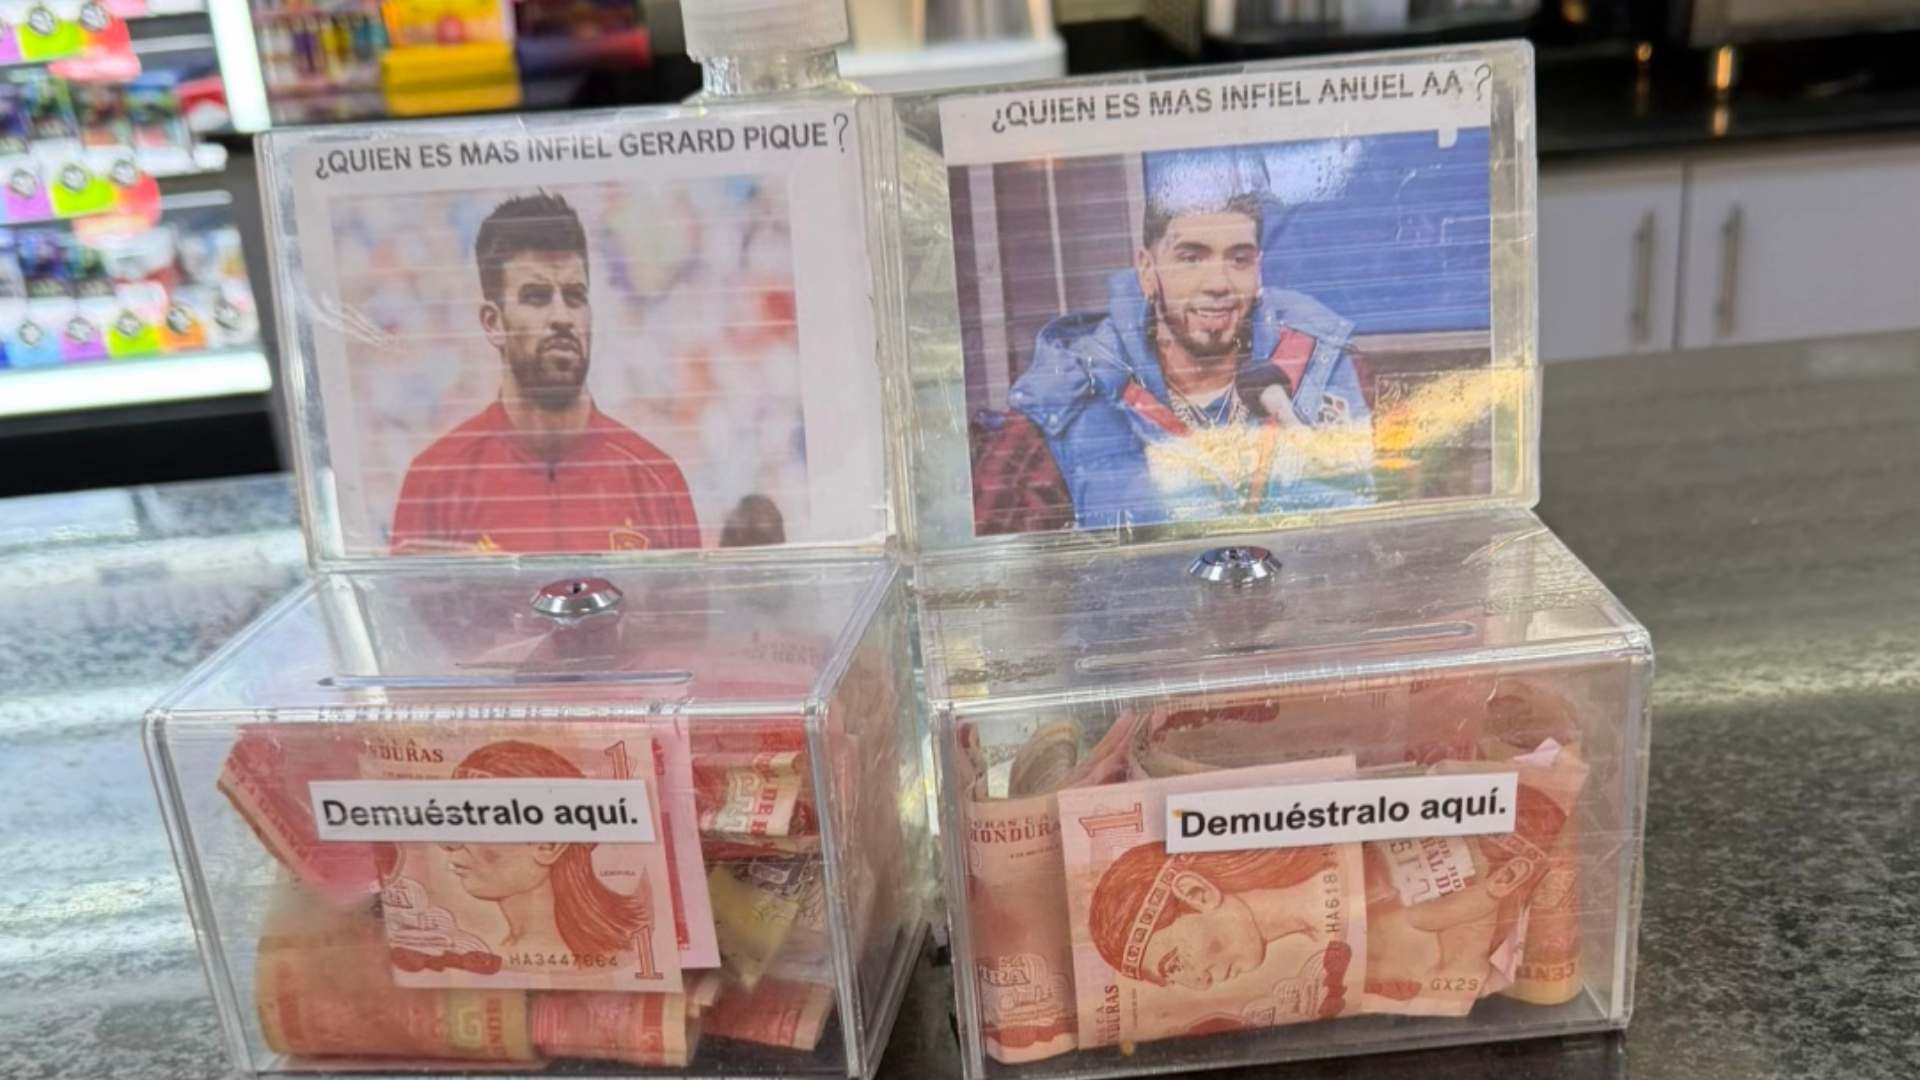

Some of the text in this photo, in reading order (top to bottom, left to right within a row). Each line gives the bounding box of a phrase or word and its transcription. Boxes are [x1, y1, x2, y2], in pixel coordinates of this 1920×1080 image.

[990, 95, 1096, 133] ¿QUIEN
[1105, 94, 1141, 120] ES
[1149, 87, 1214, 117] MAS
[1221, 79, 1312, 110] INFIEL
[1318, 72, 1414, 104] ANUEL
[315, 144, 411, 180] ¿QUIEN
[420, 143, 452, 169] ES
[460, 137, 520, 167] MAS
[527, 132, 612, 163] INFIEL
[618, 126, 735, 157] GERARD
[322, 796, 638, 831] Demuéstralo aquí.
[1181, 787, 1506, 838] Demuéstralo aquí.
